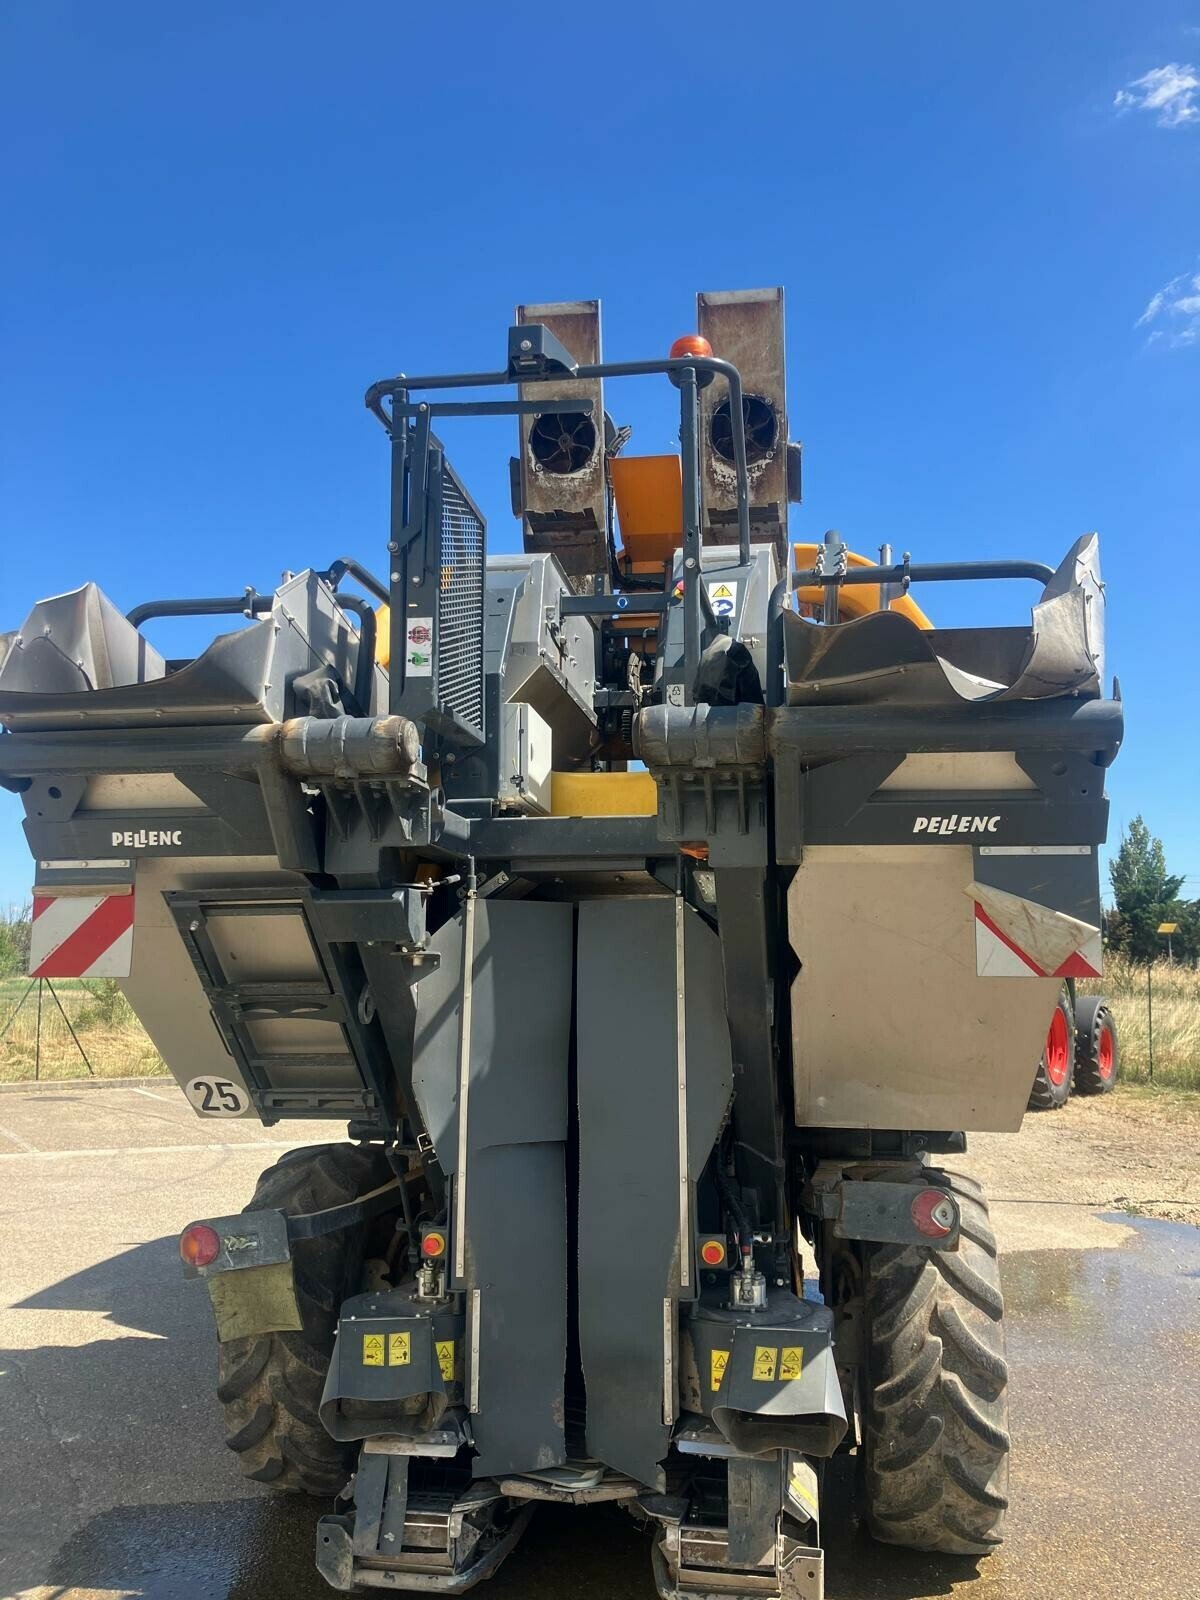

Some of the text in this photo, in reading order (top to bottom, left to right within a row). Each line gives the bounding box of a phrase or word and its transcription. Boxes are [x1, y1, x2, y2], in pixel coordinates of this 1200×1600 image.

[912, 814, 1001, 835] PELLENC
[111, 829, 182, 848] PELLENC
[193, 1081, 241, 1112] 25
